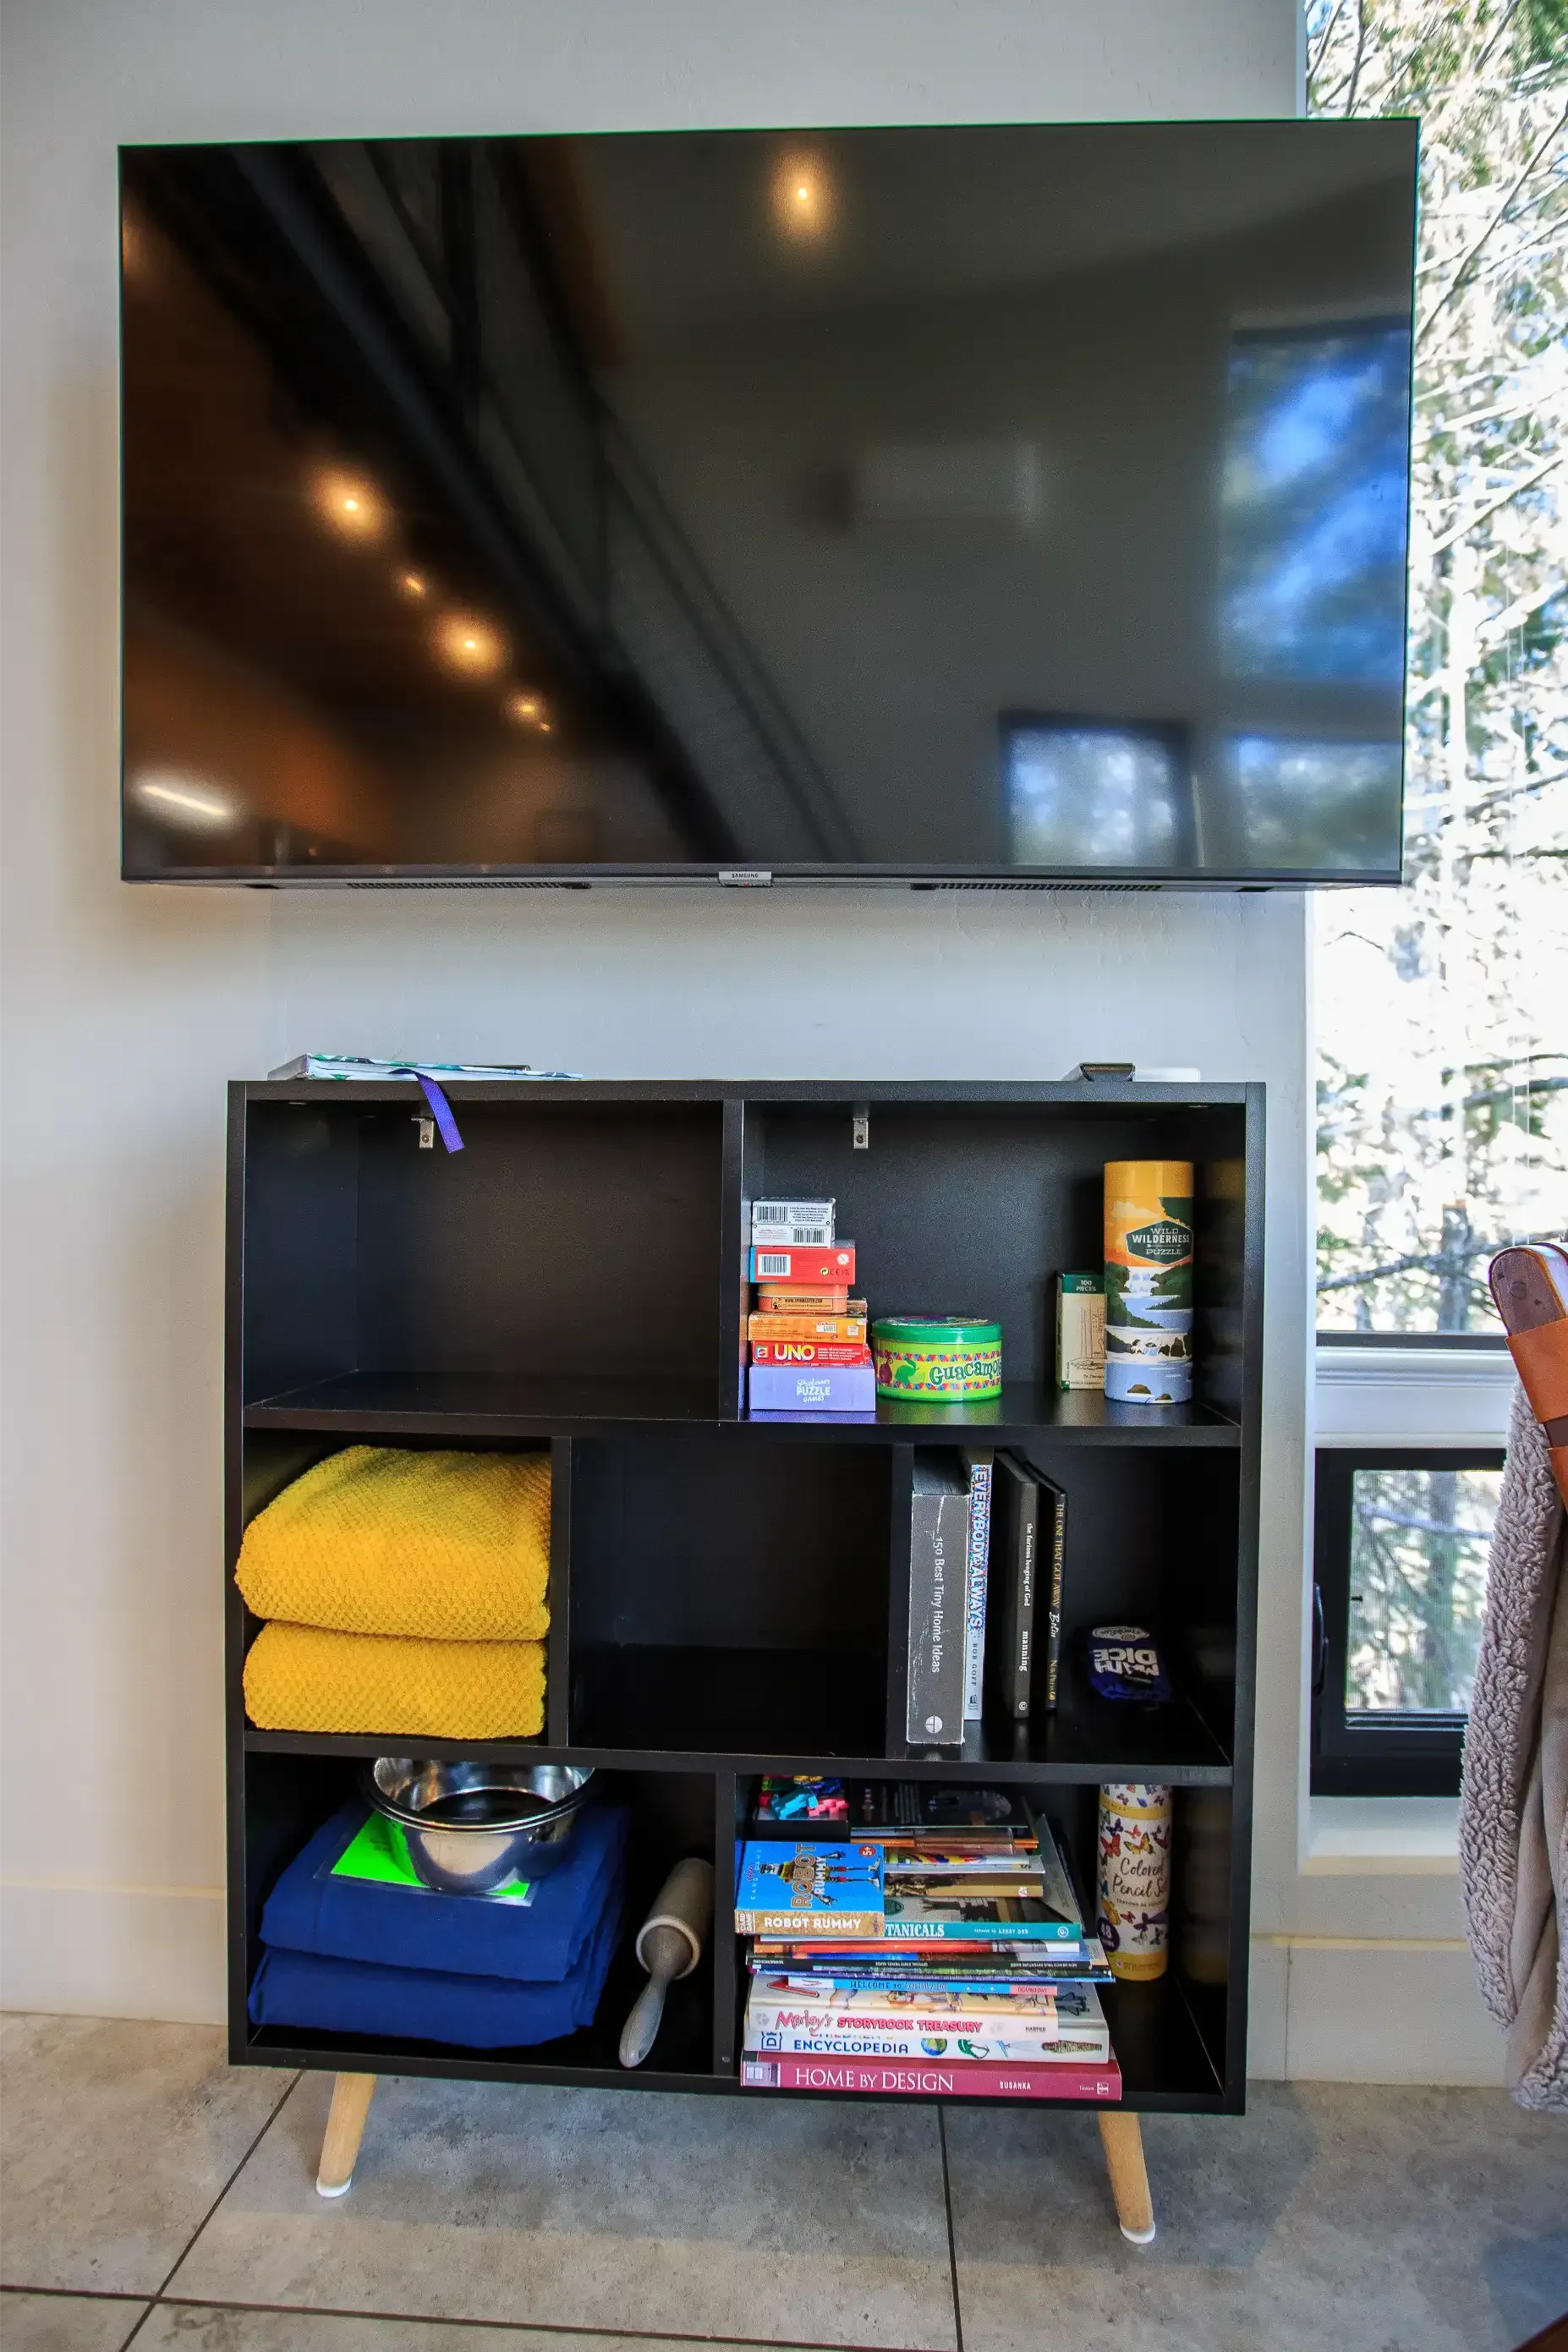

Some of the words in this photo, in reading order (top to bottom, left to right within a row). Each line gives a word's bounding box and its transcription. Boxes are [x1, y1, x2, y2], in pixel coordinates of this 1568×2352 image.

[1132, 1234, 1190, 1244] WILDERNESS
[1145, 1247, 1183, 1256] PUZZLE
[774, 1343, 815, 1361] UNO
[796, 1386, 831, 1396] PUZZLE
[797, 1377, 831, 1387] Professor
[933, 1536, 944, 1555] 150
[1054, 1539, 1063, 1560] THAT
[935, 1558, 946, 1582] Best
[1023, 1560, 1032, 1587] longing
[1053, 1563, 1062, 1582] GOT
[930, 1584, 945, 1609] Tiny
[968, 1564, 985, 1630] ALWAYS
[1051, 1583, 1061, 1609] AWAY
[932, 1610, 944, 1642] Home
[1049, 1611, 1060, 1638] Bolin
[931, 1644, 943, 1674] Ideas
[1018, 1631, 1029, 1672] manning
[1093, 1647, 1158, 1664] DICE
[1094, 1660, 1160, 1676] MATH
[861, 1846, 873, 1856] 5+
[791, 1843, 816, 1908] ROBOT
[814, 1856, 827, 1895] RUMMY
[1112, 1873, 1153, 1898] Pencil
[764, 1916, 809, 1929] ROBOT
[813, 1917, 862, 1929] RUMMY
[850, 1980, 891, 1988] WELCOME
[904, 1982, 947, 1991] COLORADO
[775, 2009, 834, 2037] Marley's
[836, 2016, 914, 2031] STORYBOOK
[916, 2019, 983, 2033] TREASURY
[793, 2039, 909, 2054] ENCYCLOPEDIA
[795, 2068, 855, 2087] HOME
[859, 2073, 878, 2089] BY
[881, 2071, 953, 2092] DESIGN
[999, 2081, 1032, 2090] SUSANKA
